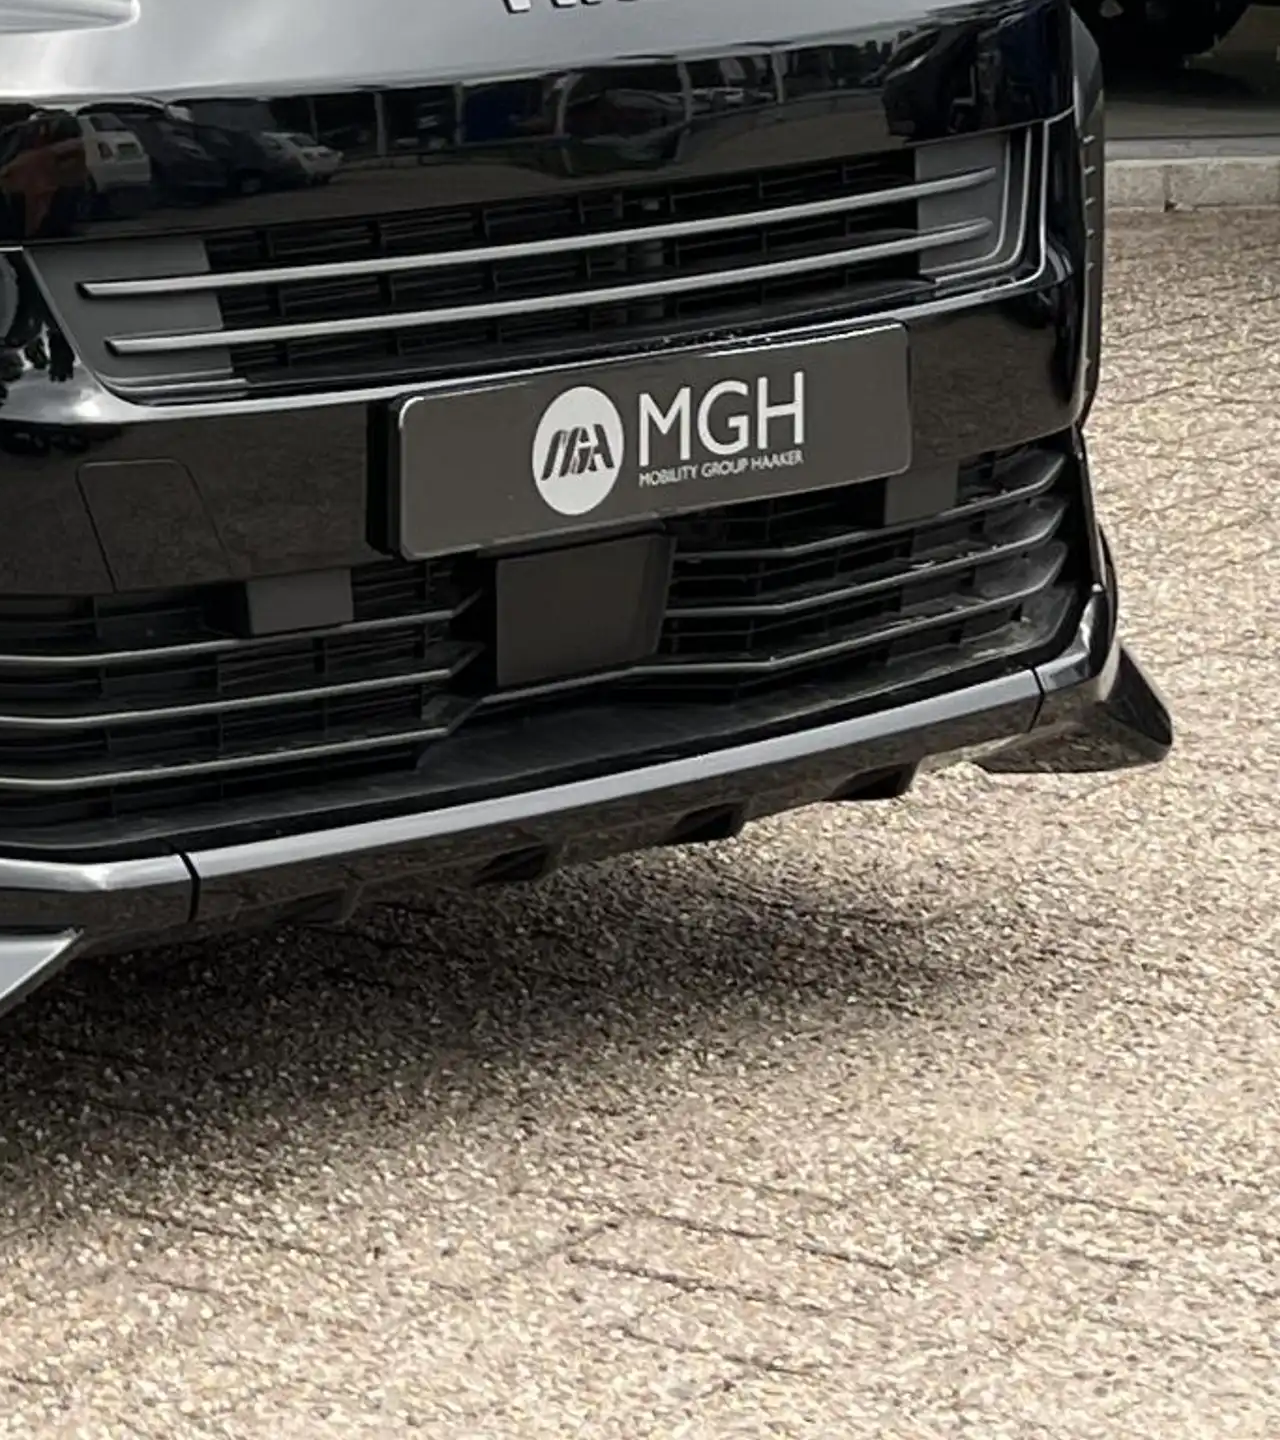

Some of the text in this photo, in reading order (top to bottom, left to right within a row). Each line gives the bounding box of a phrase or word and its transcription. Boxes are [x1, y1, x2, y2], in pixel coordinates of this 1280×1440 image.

[639, 371, 805, 467] MGH
[639, 464, 698, 487] MOBILITY
[701, 457, 749, 478] GROUP
